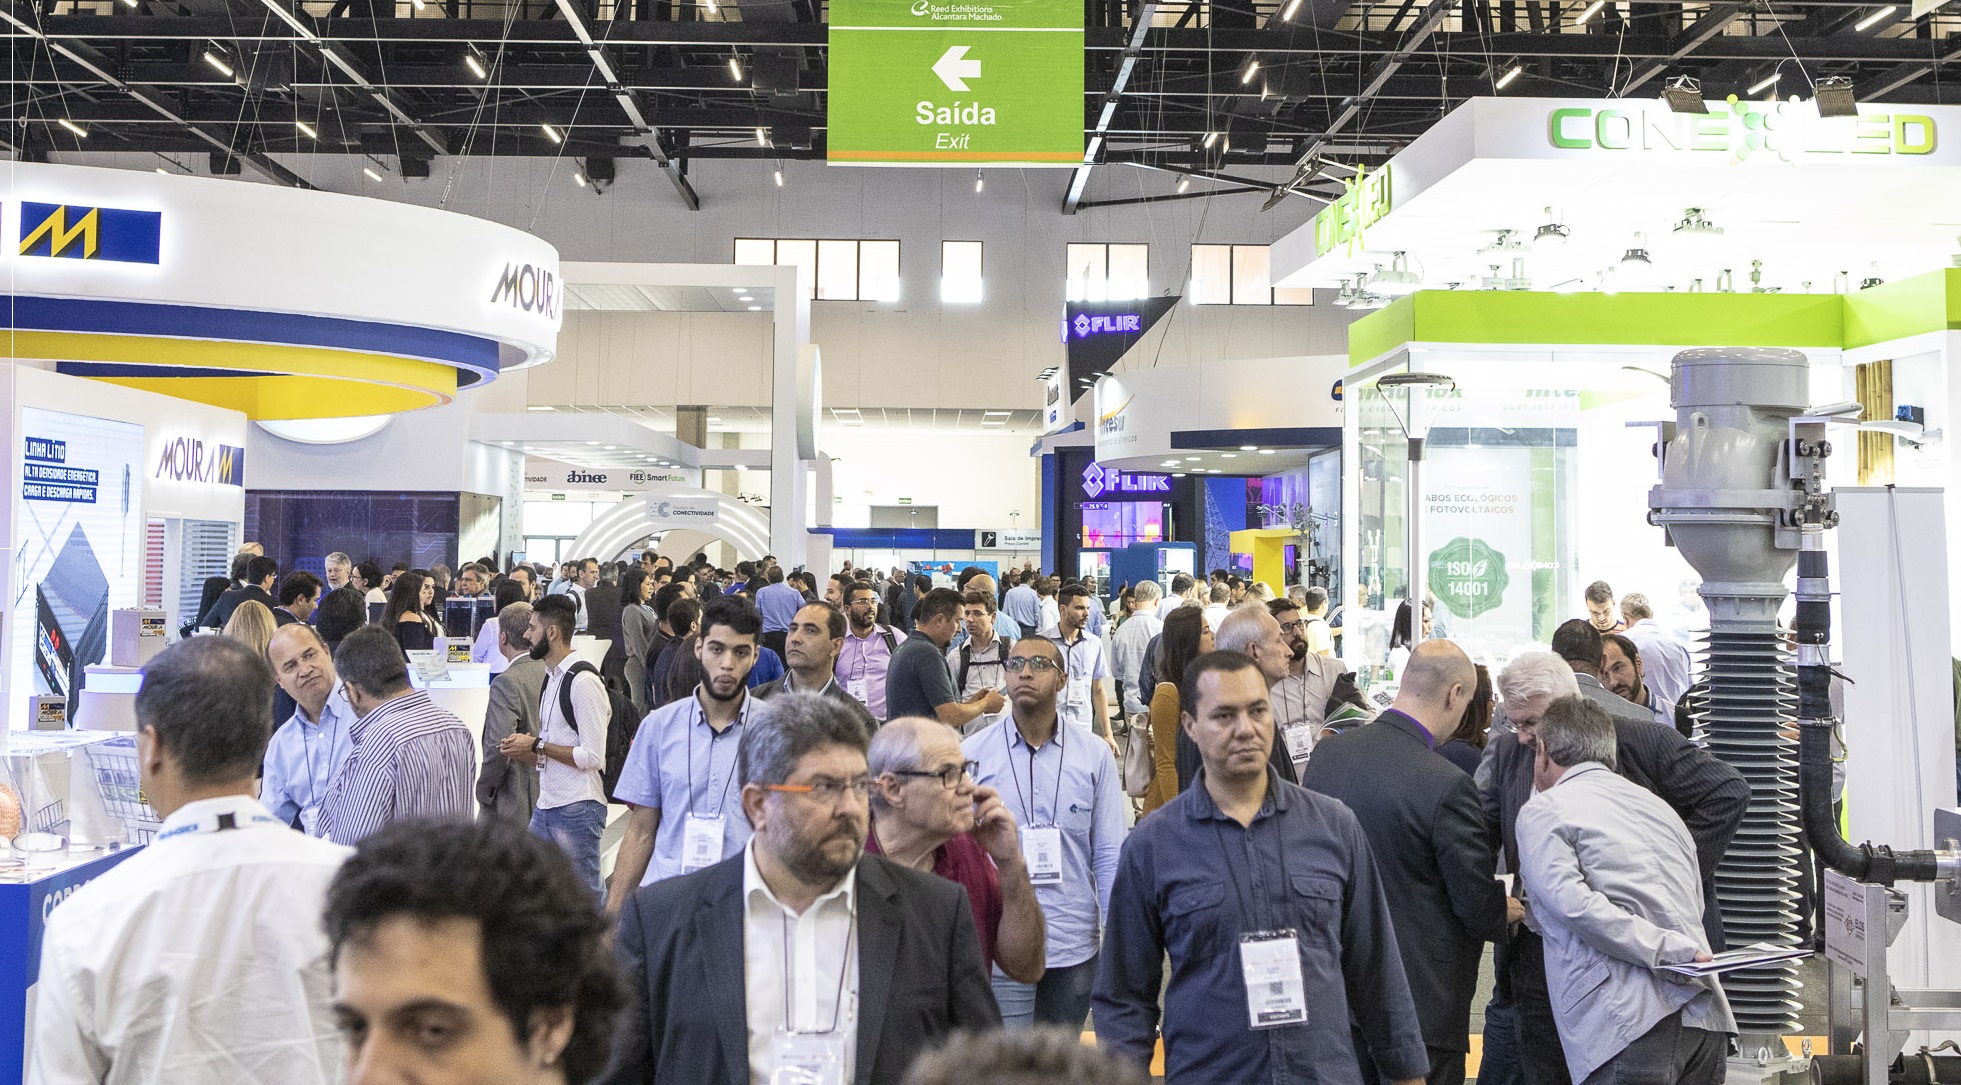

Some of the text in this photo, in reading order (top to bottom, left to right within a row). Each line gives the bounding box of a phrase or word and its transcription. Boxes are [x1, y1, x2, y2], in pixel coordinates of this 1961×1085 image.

[930, 5, 993, 13] Reed Exhibitions
[916, 100, 996, 125] Saída
[935, 133, 970, 149] Exit
[1091, 315, 1140, 332] FLIR
[155, 436, 215, 483] MOURA
[24, 465, 39, 478] ALTA
[39, 466, 67, 480] DENSIDADE
[629, 472, 645, 483] FIEE
[647, 473, 668, 482] Smart
[668, 474, 685, 482] Future
[24, 484, 41, 497] CARGA
[42, 485, 46, 497] E
[1447, 561, 1471, 576] ISO
[1448, 581, 1489, 596] 14001
